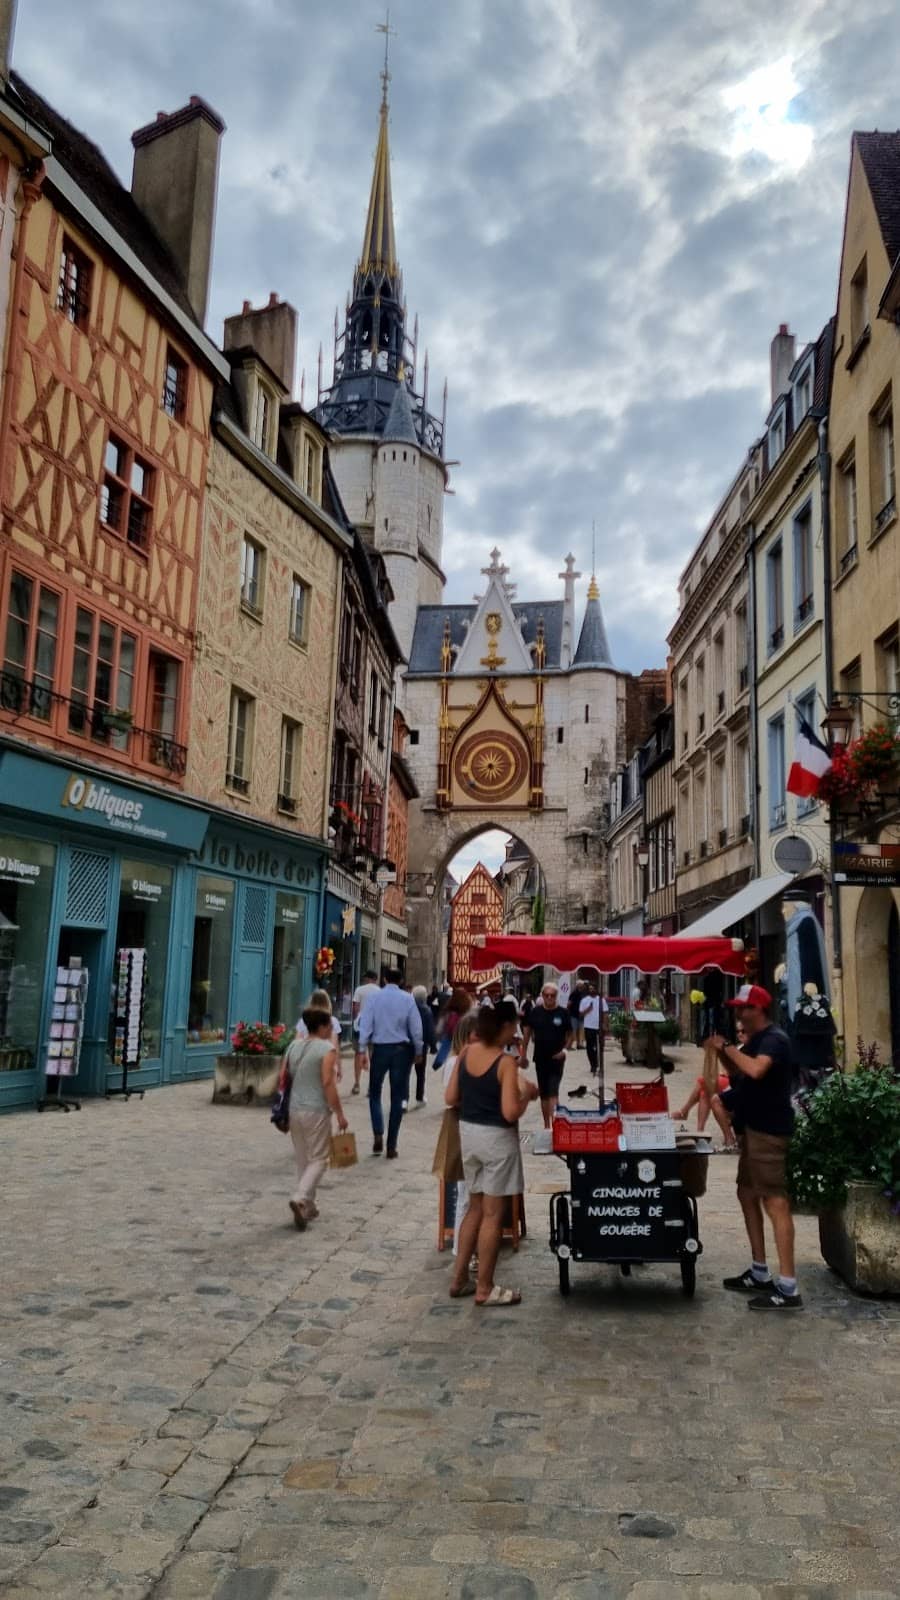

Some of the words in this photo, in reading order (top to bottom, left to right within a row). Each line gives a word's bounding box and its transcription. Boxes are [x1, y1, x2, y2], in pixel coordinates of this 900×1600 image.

[592, 1187, 661, 1199] CINQUANTE
[588, 1206, 640, 1217] NUANCES
[648, 1206, 663, 1217] DE
[600, 1221, 651, 1236] GOUGÈRE
